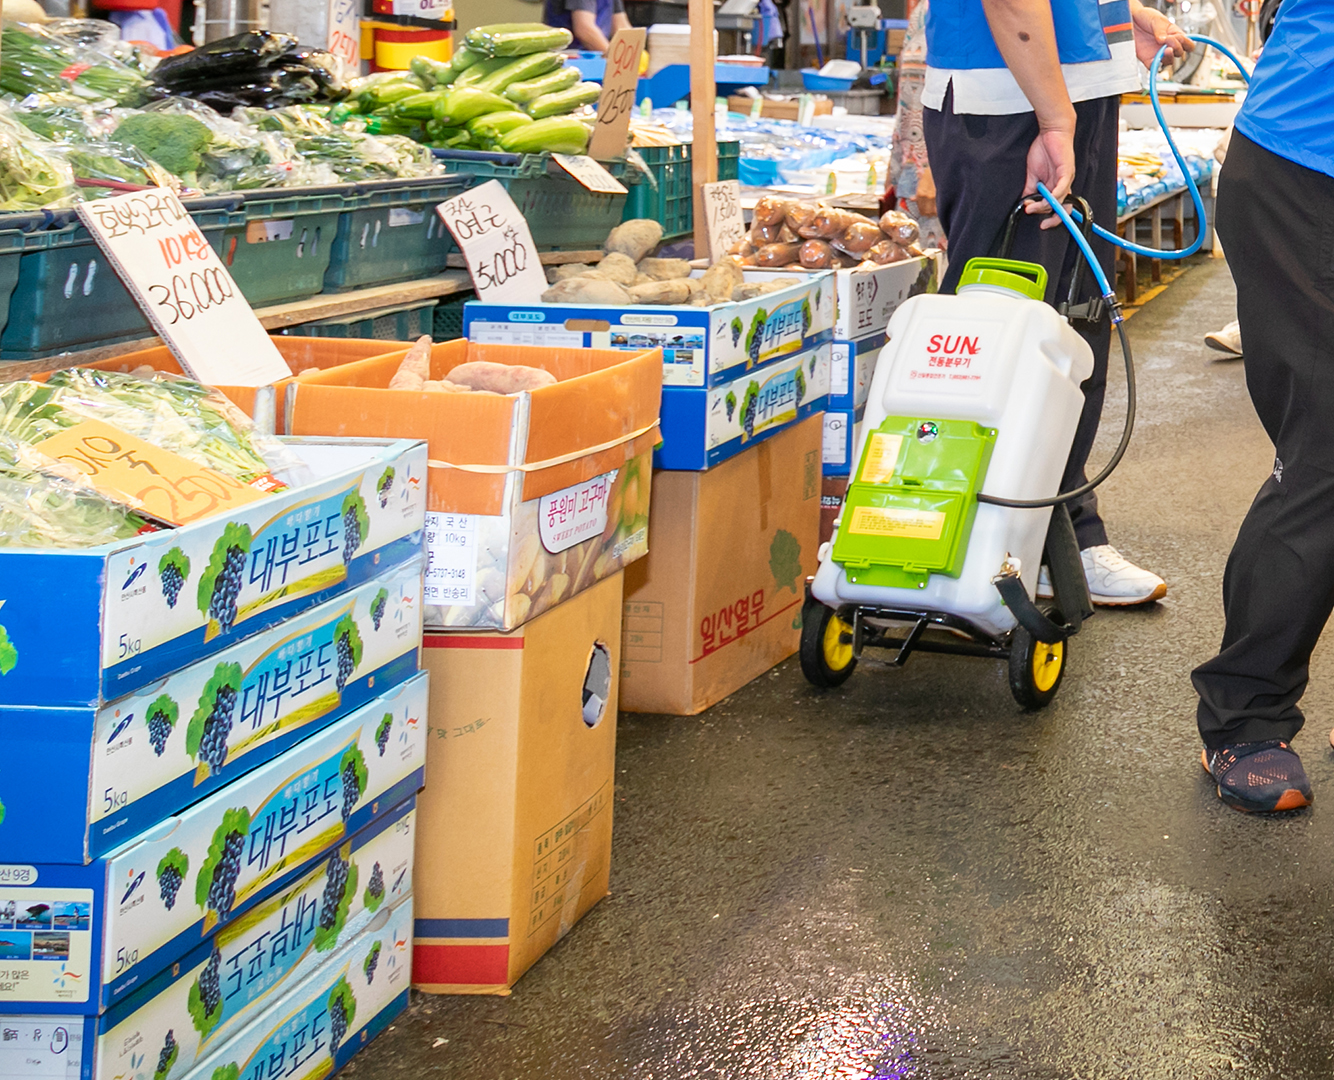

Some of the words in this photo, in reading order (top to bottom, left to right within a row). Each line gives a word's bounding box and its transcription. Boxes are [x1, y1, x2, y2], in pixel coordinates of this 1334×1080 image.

[455, 204, 507, 239] 연근
[476, 242, 527, 290] 5,000
[148, 267, 234, 324] 36,000
[926, 334, 979, 355] SUN
[928, 356, 971, 368] 전동분무기
[548, 493, 577, 528] 풍원미
[579, 478, 608, 513] 고구마
[445, 533, 466, 546] 10kg
[552, 526, 572, 544] SWEET
[574, 518, 598, 535] POTATO
[249, 512, 342, 594] 대부포도
[443, 586, 468, 599] 반송리
[700, 589, 765, 657] 일산열무
[118, 633, 142, 659] 5kg
[240, 640, 333, 731] 대부포도
[103, 786, 128, 814] 5kg
[247, 771, 340, 873] 대부포도
[115, 945, 139, 975] 5kg
[226, 891, 318, 1001] 대부포도
